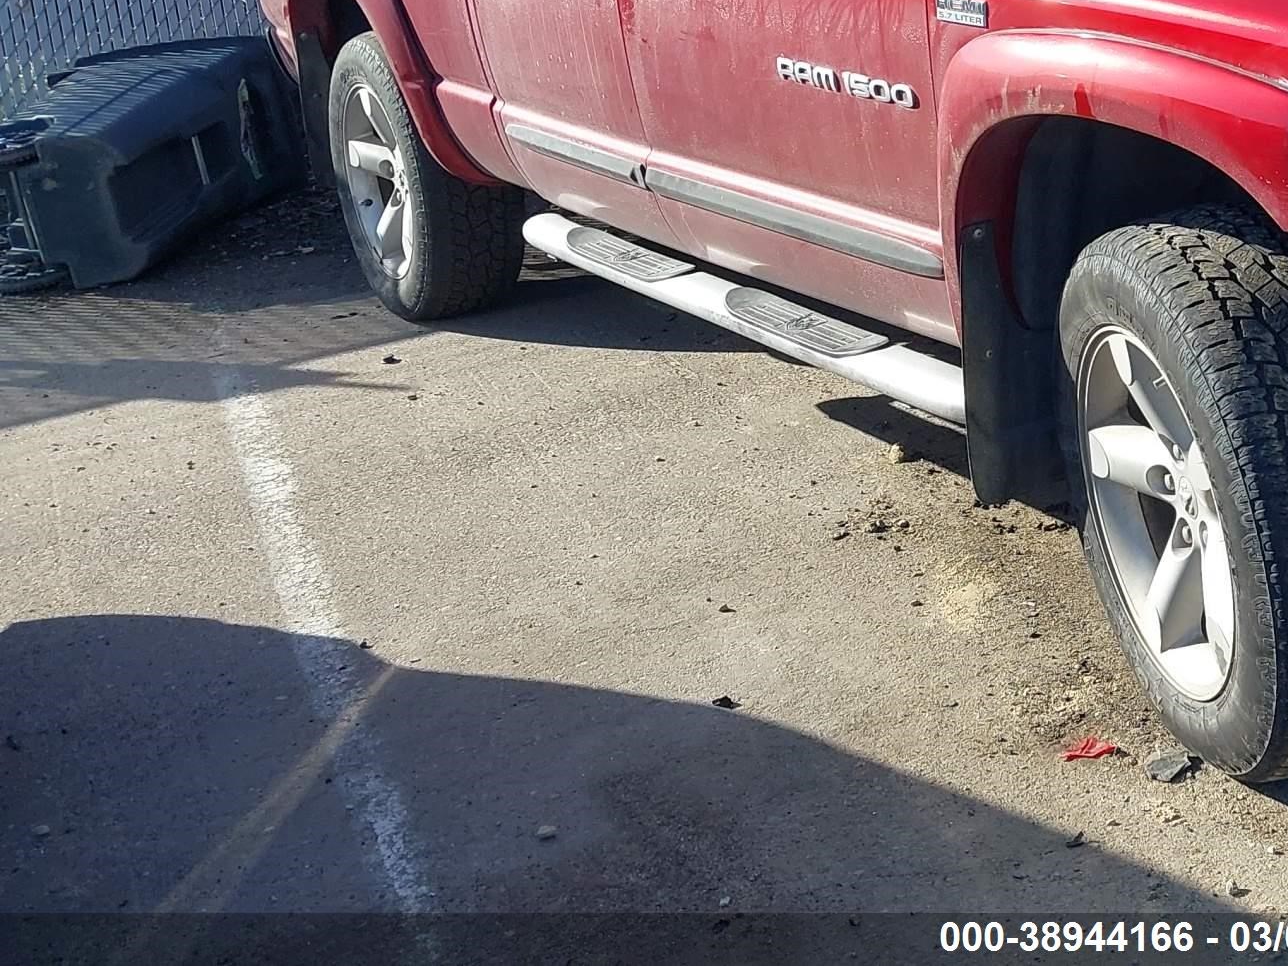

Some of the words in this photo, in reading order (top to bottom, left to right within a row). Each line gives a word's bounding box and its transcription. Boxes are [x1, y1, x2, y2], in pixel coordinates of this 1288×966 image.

[938, 11, 953, 19] 5.7
[954, 13, 982, 24] LITER
[776, 56, 837, 92] RAM
[841, 71, 915, 108] 1500
